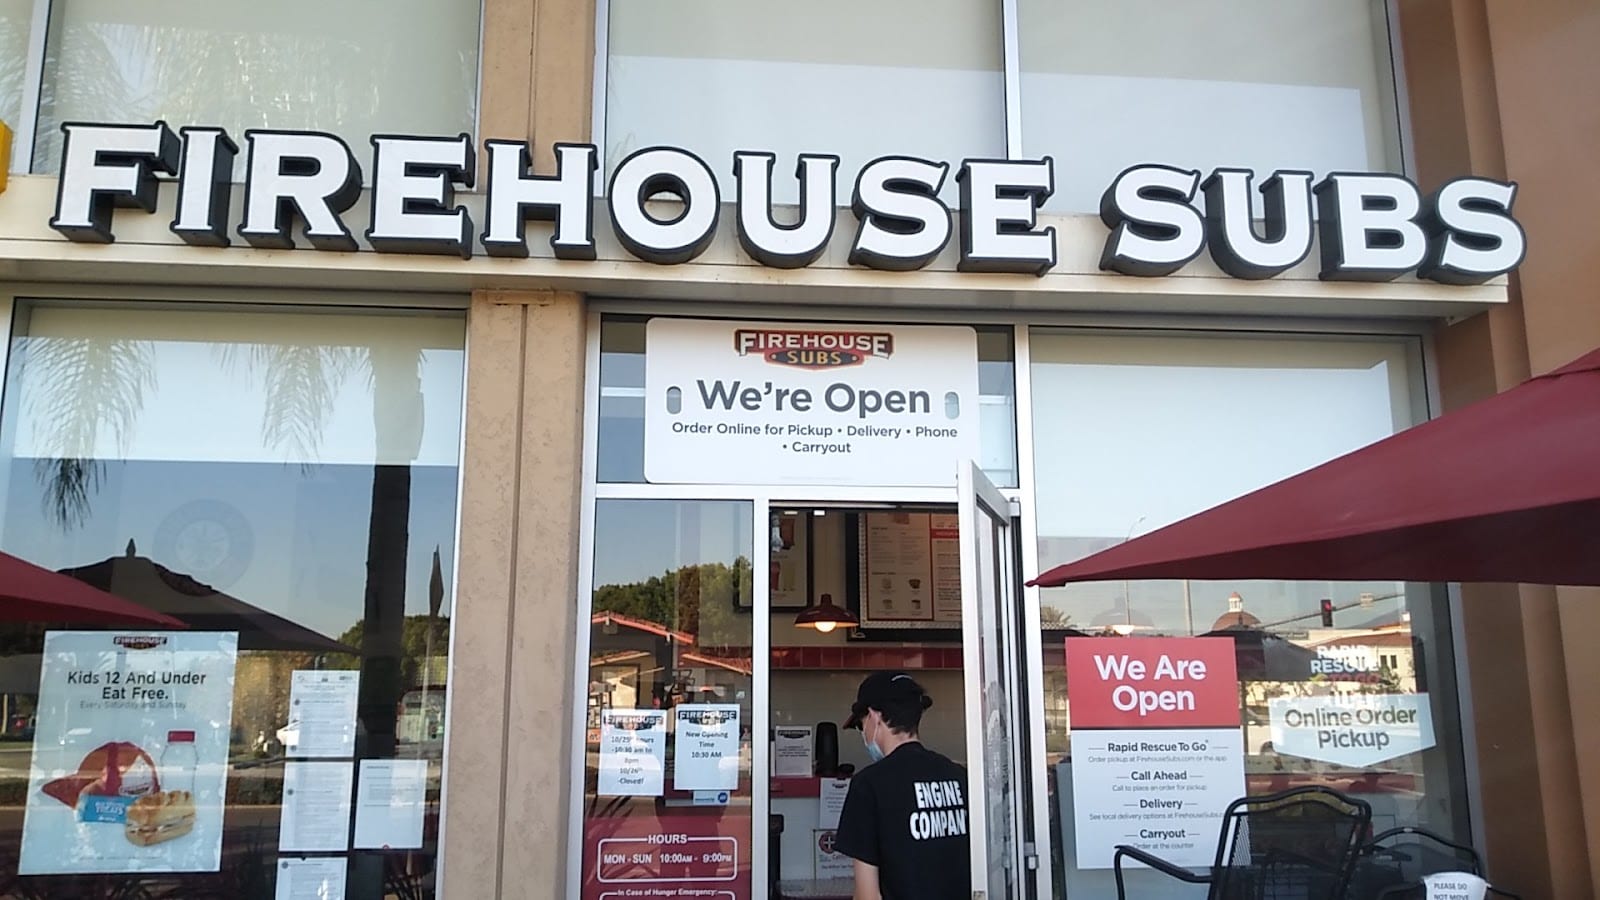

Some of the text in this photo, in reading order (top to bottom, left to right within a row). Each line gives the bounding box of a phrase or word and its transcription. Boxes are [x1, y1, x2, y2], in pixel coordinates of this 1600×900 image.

[50, 120, 1527, 285] FIREHOUSE SUBS
[738, 331, 890, 359] FIREHOUSE
[786, 350, 842, 365] SUBS
[696, 379, 931, 419] We're Open
[671, 422, 959, 439] Order Online for Pickup Delivery Phone
[791, 441, 852, 455] Carryout
[1093, 655, 1207, 681] We Are
[67, 671, 206, 685] Kids 12 And Under
[102, 687, 169, 700] Eat Free.
[1112, 685, 1195, 716] Open
[1284, 705, 1417, 727] Online Order
[1318, 730, 1390, 750] Pickup
[1108, 743, 1138, 754] Rapid
[1141, 742, 1177, 752] Rescue
[1177, 742, 1190, 751] To
[1131, 770, 1187, 781] Call Ahead
[913, 781, 964, 809] ENGINE
[1112, 784, 1124, 792] Call
[1139, 799, 1183, 810] Delivery
[1117, 813, 1142, 821] delivery
[909, 809, 967, 841] COMPAN
[648, 834, 688, 844] HOURS
[1139, 829, 1186, 840] Carryout
[603, 854, 626, 864] MON
[632, 854, 652, 864] SUN
[660, 853, 693, 863] 10:00AM
[702, 853, 732, 863] 9:00PM
[652, 889, 677, 898] Hunger
